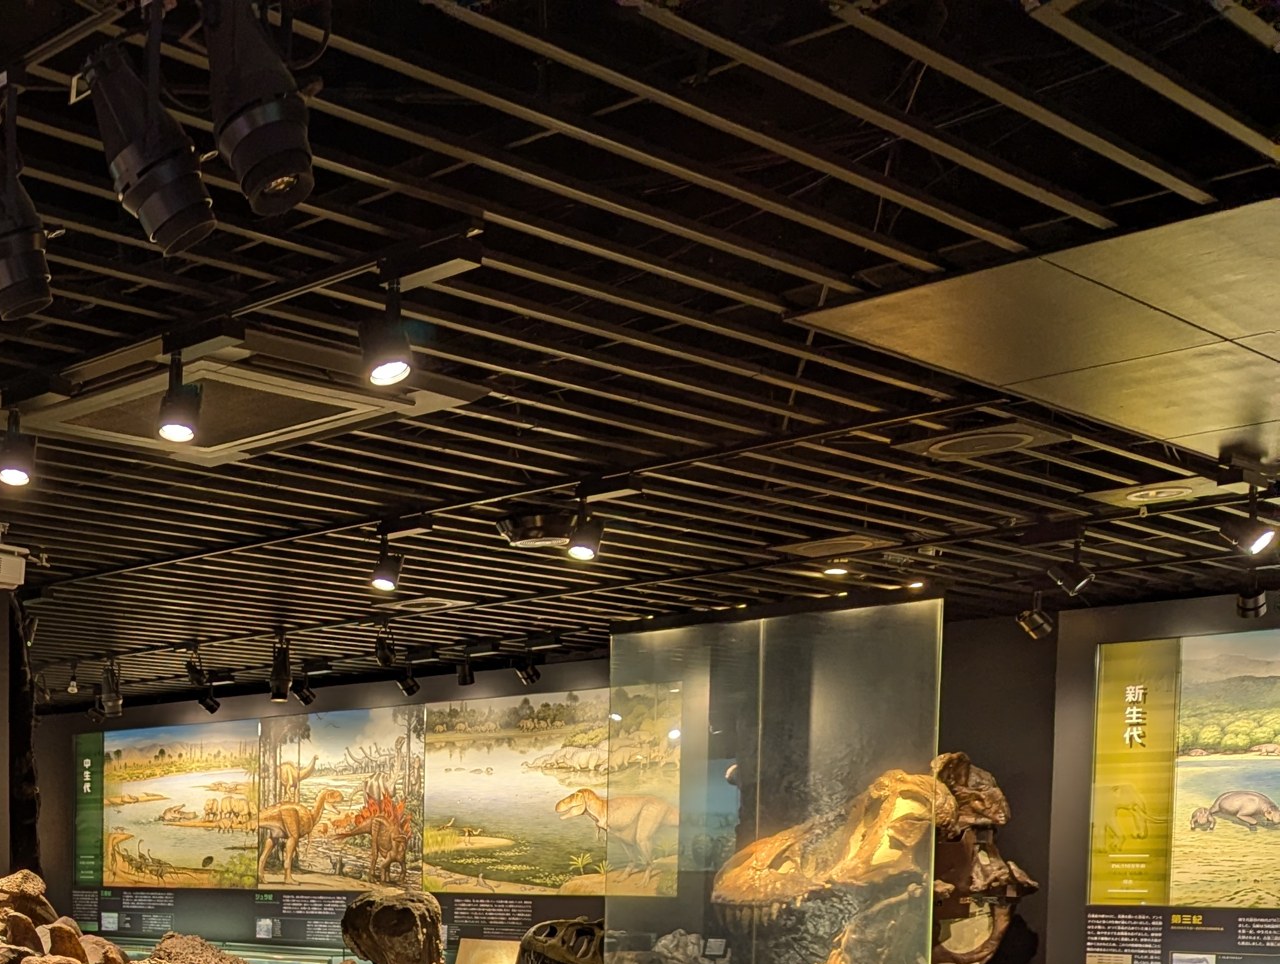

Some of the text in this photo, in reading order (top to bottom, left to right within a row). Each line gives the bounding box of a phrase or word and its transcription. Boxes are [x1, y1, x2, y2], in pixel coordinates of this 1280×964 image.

[1124, 684, 1145, 746] 新生代
[83, 758, 91, 793] 中生代
[1170, 913, 1203, 925] 第三紀
